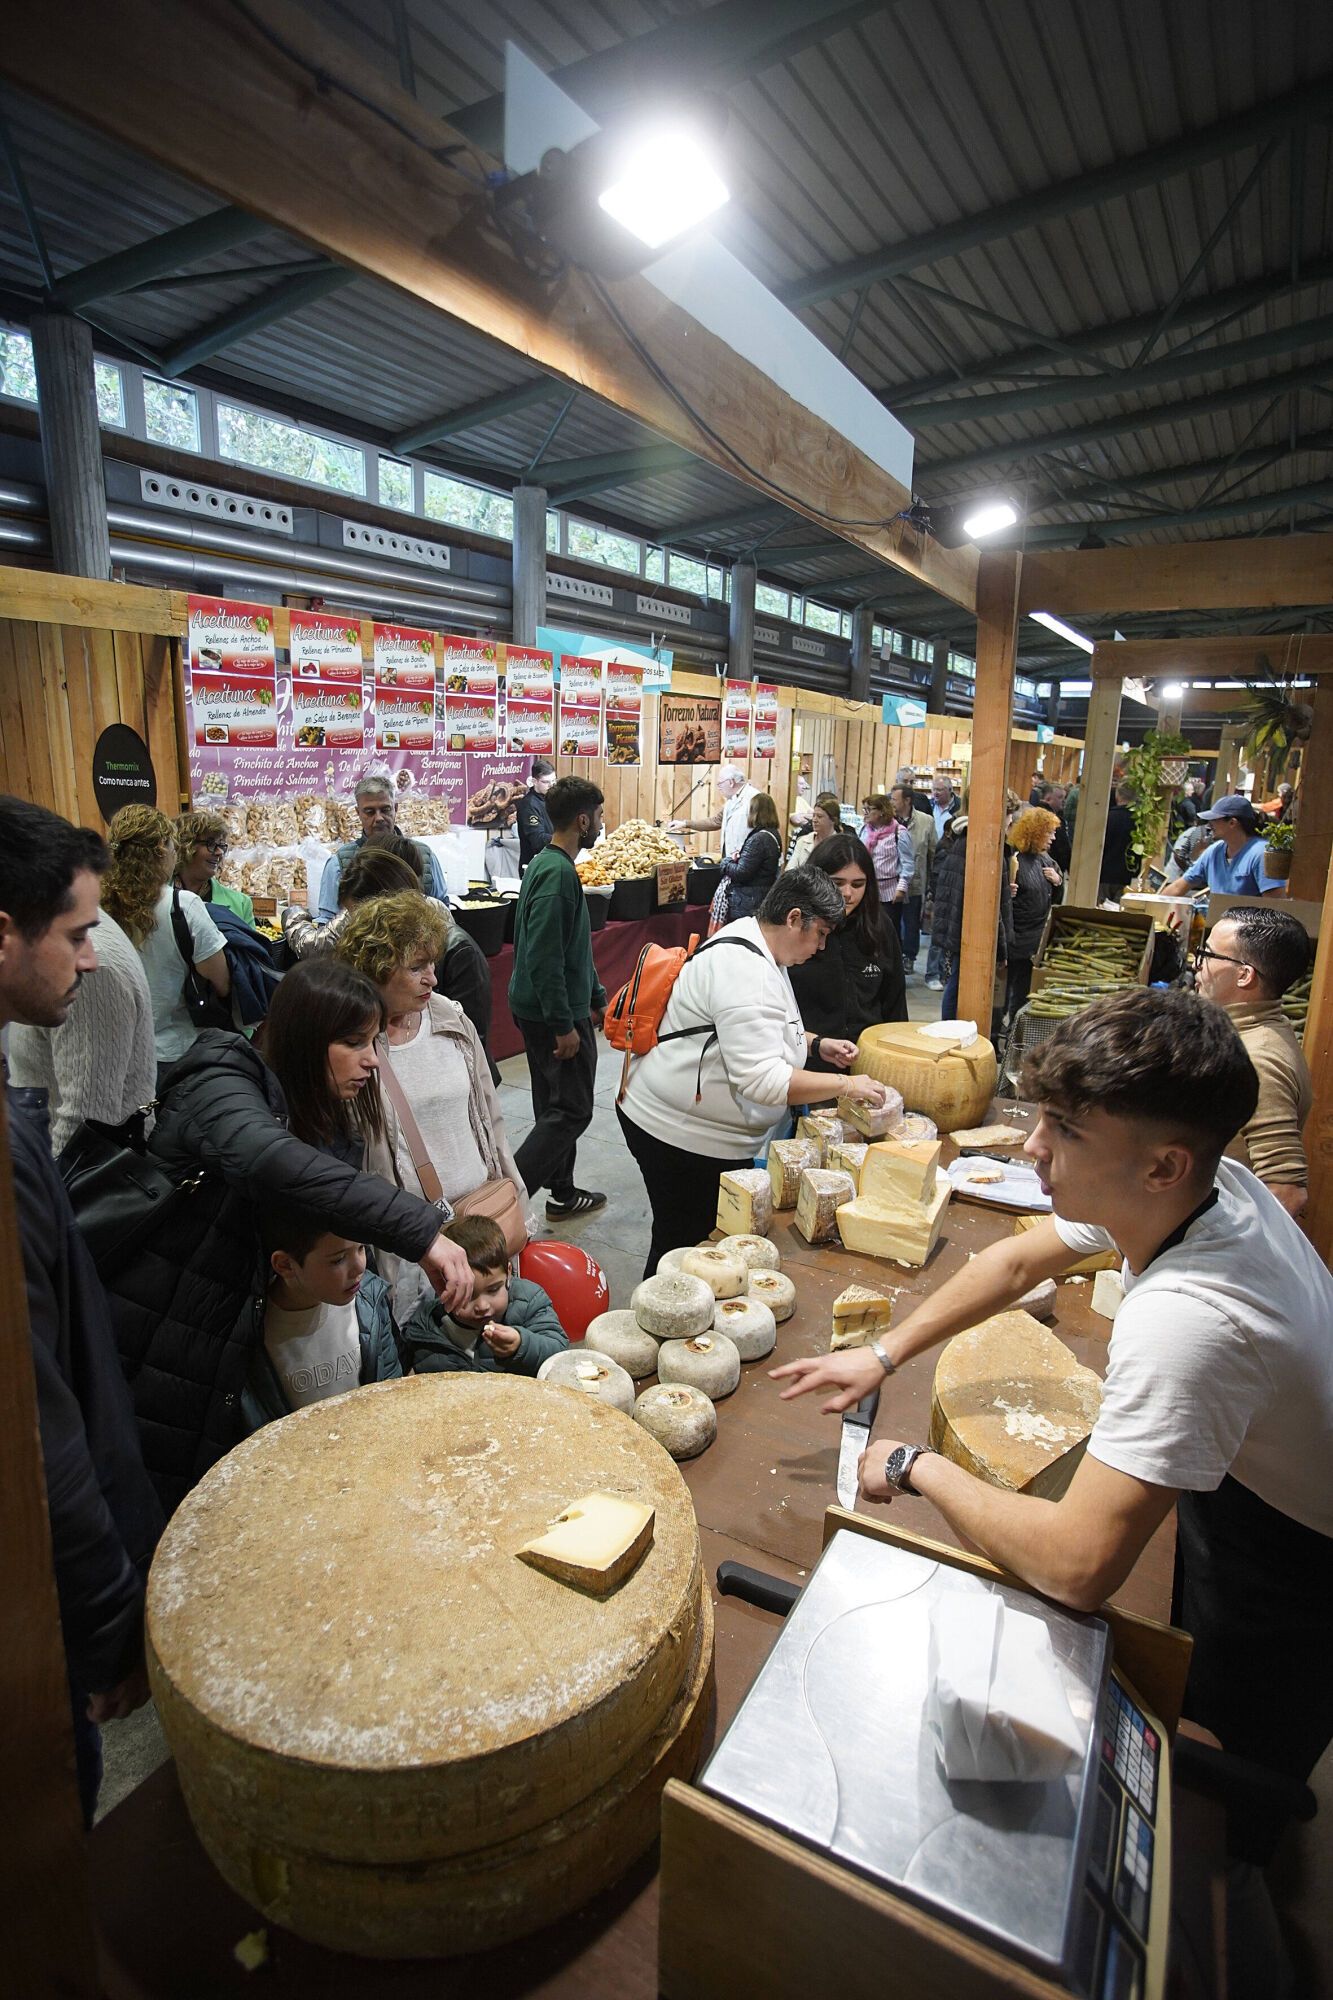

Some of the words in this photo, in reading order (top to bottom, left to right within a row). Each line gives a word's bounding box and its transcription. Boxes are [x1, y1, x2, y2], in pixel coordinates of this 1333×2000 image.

[191, 608, 254, 630] Aceitunas
[293, 621, 344, 641] Aceitunas
[204, 634, 229, 645] Rellenas
[230, 634, 238, 644] de
[240, 634, 262, 643] Anchoa
[376, 633, 420, 651] Aceitunas
[301, 646, 322, 655] Rellenas
[323, 646, 330, 654] de
[446, 643, 485, 660] Aceitunas
[508, 653, 543, 669] Aceitunas
[562, 662, 592, 677] Aceitunas
[608, 669, 635, 683] Aceitunas
[196, 683, 257, 705] Aceitunas
[295, 689, 347, 710] Aceitunas
[207, 708, 231, 720] Rellenas
[232, 708, 240, 718] de
[242, 706, 267, 716] Almendra
[377, 697, 421, 716] Aceitunas
[447, 702, 485, 720] Aceitunas
[663, 703, 695, 722] Torrezno
[696, 703, 720, 722] Natural
[305, 716, 312, 724] en
[313, 712, 328, 724] Salsa
[329, 711, 336, 722] de
[383, 718, 404, 729] Rellenas
[508, 708, 543, 724] Aceitunas
[561, 711, 592, 727] Aceitunas
[105, 761, 140, 771] Thermomix
[233, 755, 273, 769] Pinchito
[273, 755, 285, 769] de
[286, 755, 319, 769] Anchoa
[420, 757, 462, 775] Berenjenas
[481, 762, 524, 779] ¡Pruébalos!
[98, 776, 116, 785] Como
[116, 778, 134, 786] nunca
[134, 779, 150, 788] antes
[233, 772, 272, 787] Pinchito
[273, 772, 284, 786] de
[285, 771, 318, 786] Salmón
[418, 771, 428, 786] de
[429, 773, 464, 791] Almagro
[286, 1346, 360, 1393] ODAY
